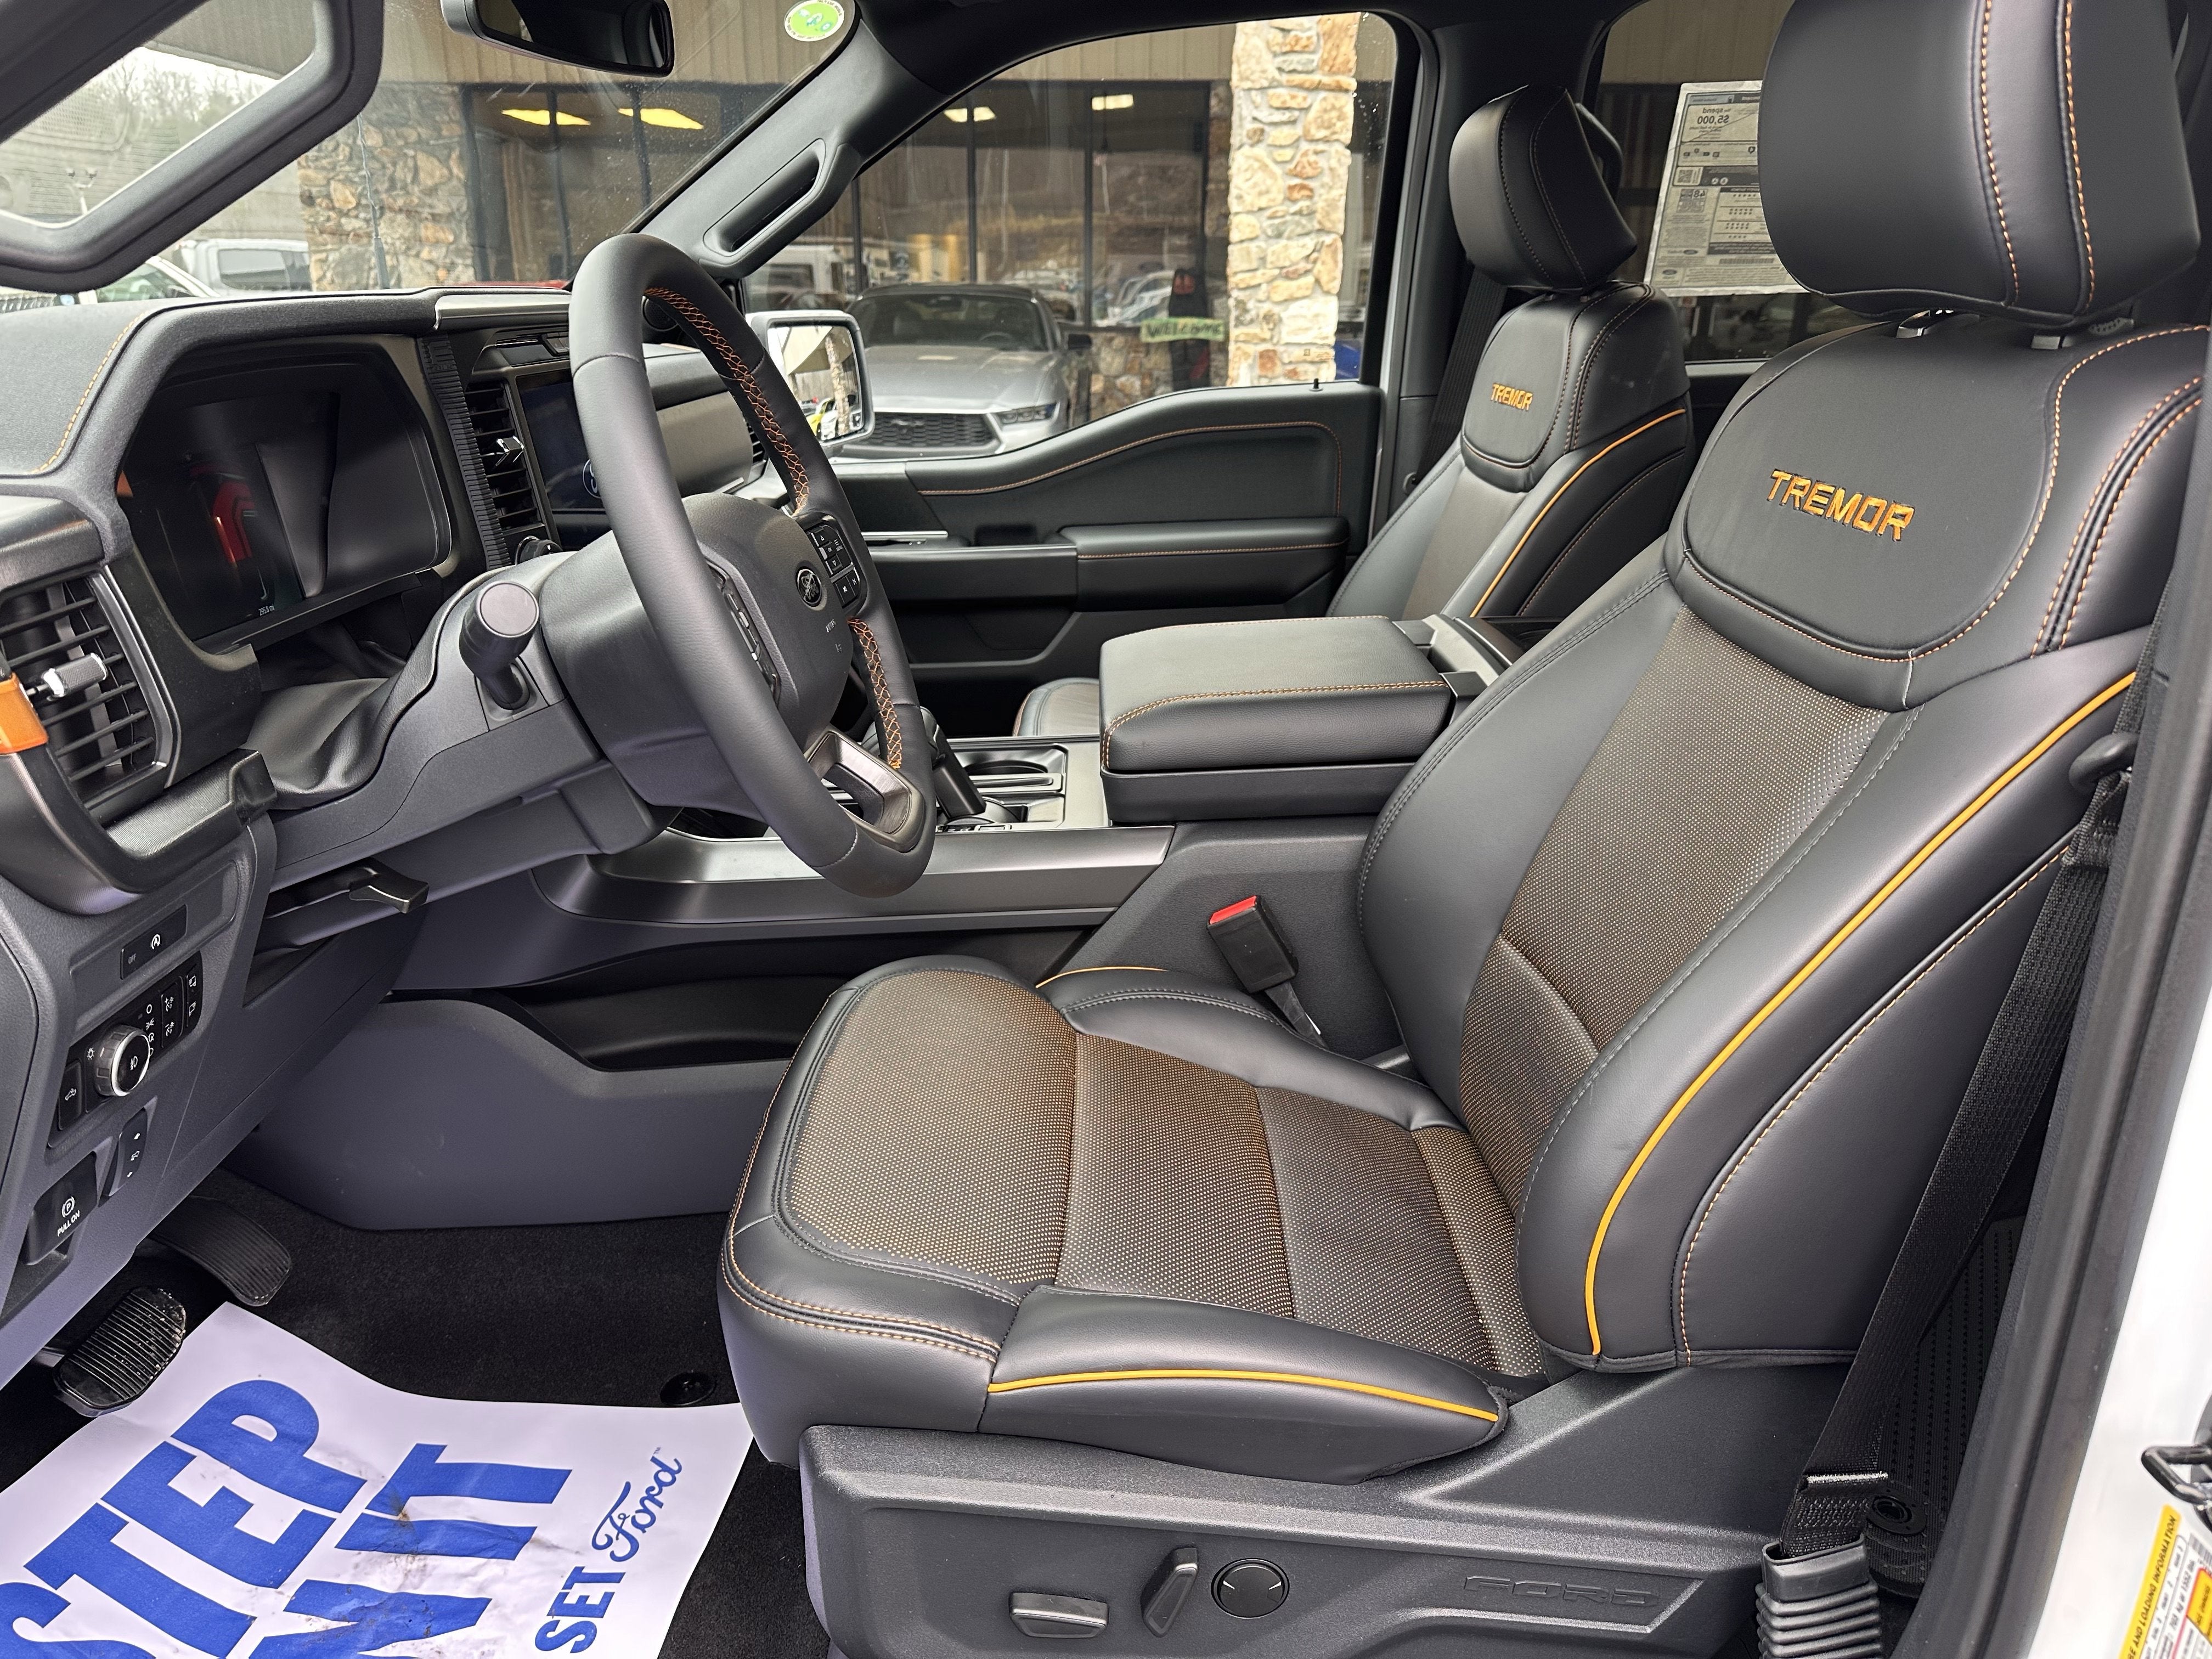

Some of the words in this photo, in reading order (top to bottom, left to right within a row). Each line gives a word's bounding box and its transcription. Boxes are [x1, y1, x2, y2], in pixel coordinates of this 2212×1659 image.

[1490, 382, 1533, 411] TREMOR
[1766, 468, 1916, 542] TREMOR
[57, 1220, 71, 1237] PULL
[71, 1210, 80, 1223] ON
[534, 1565, 627, 1654] SET
[591, 1455, 684, 1562] Ford
[1464, 1575, 1659, 1608] FORD
[2132, 1626, 2144, 1648] AND
[2138, 1583, 2157, 1627] LOADING
[2152, 1515, 2177, 1584] INFORMATION
